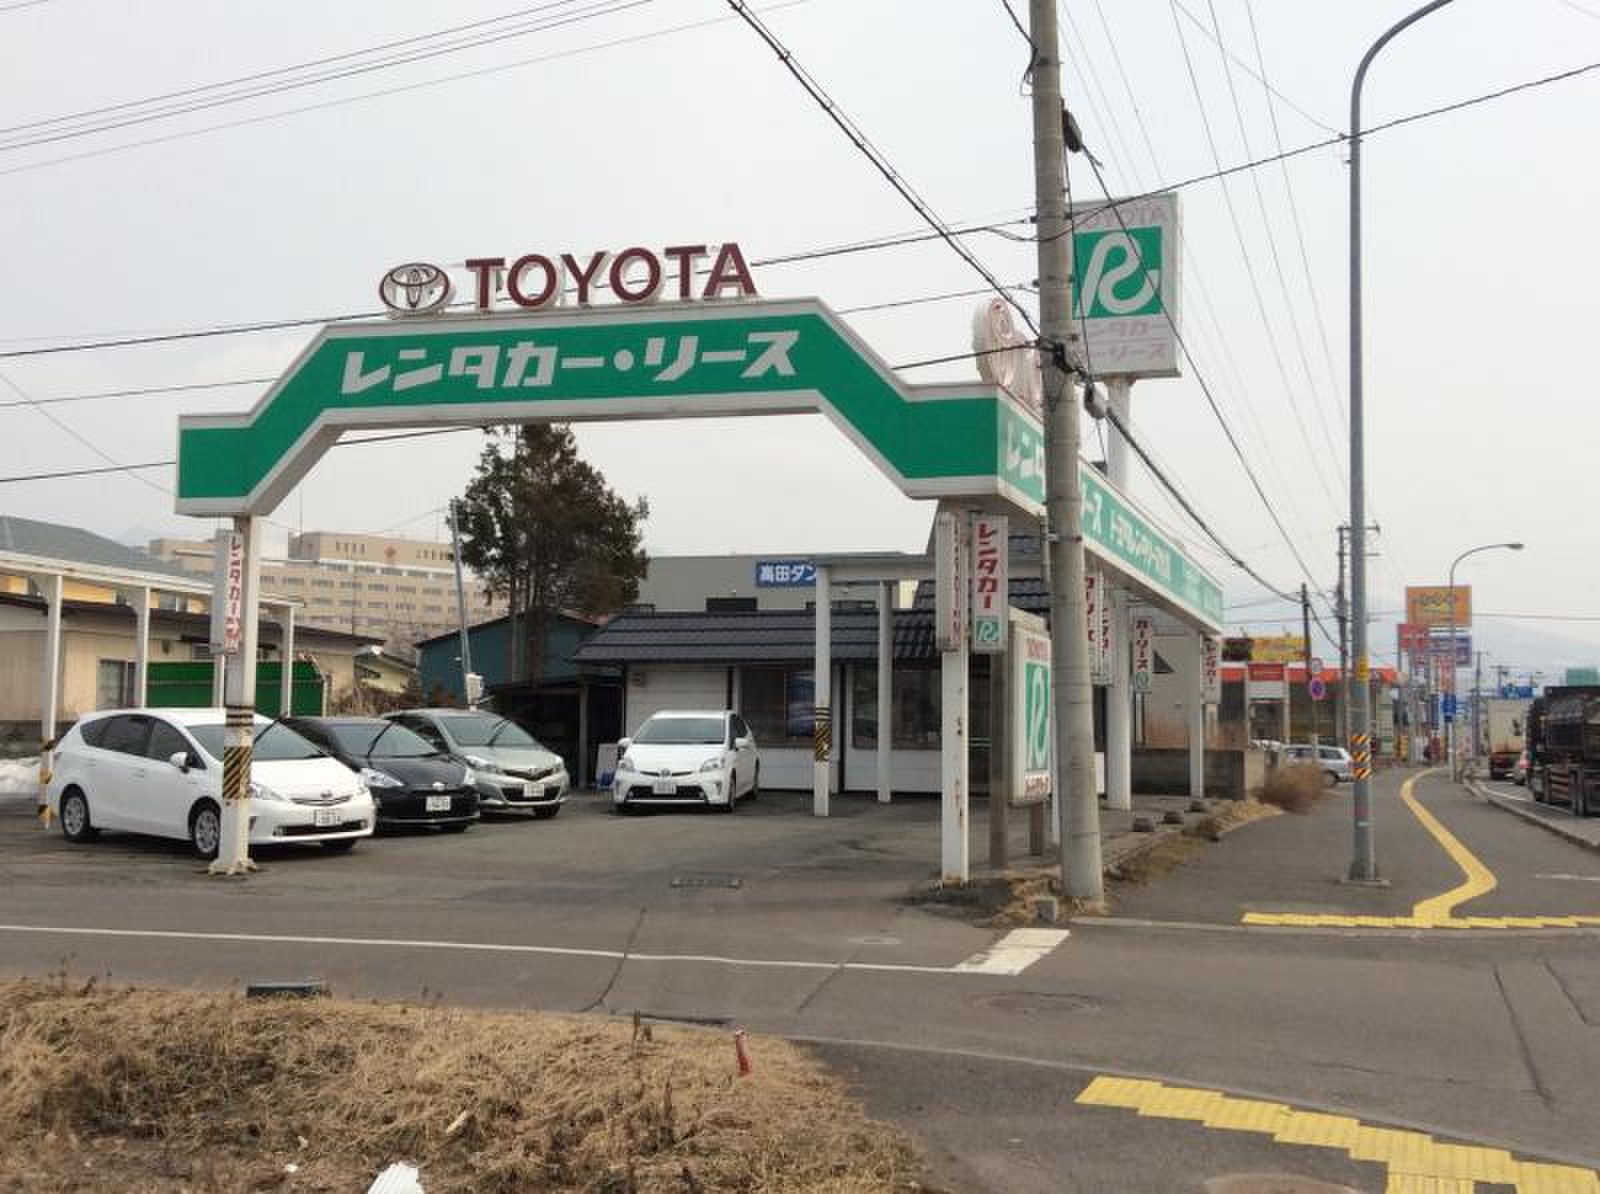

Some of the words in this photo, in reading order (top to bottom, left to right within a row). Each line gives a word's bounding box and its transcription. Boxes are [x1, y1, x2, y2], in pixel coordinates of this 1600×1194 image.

[464, 242, 758, 311] TOYOTA
[341, 329, 801, 395] レンタカー・リース
[976, 522, 999, 609] レンタカー
